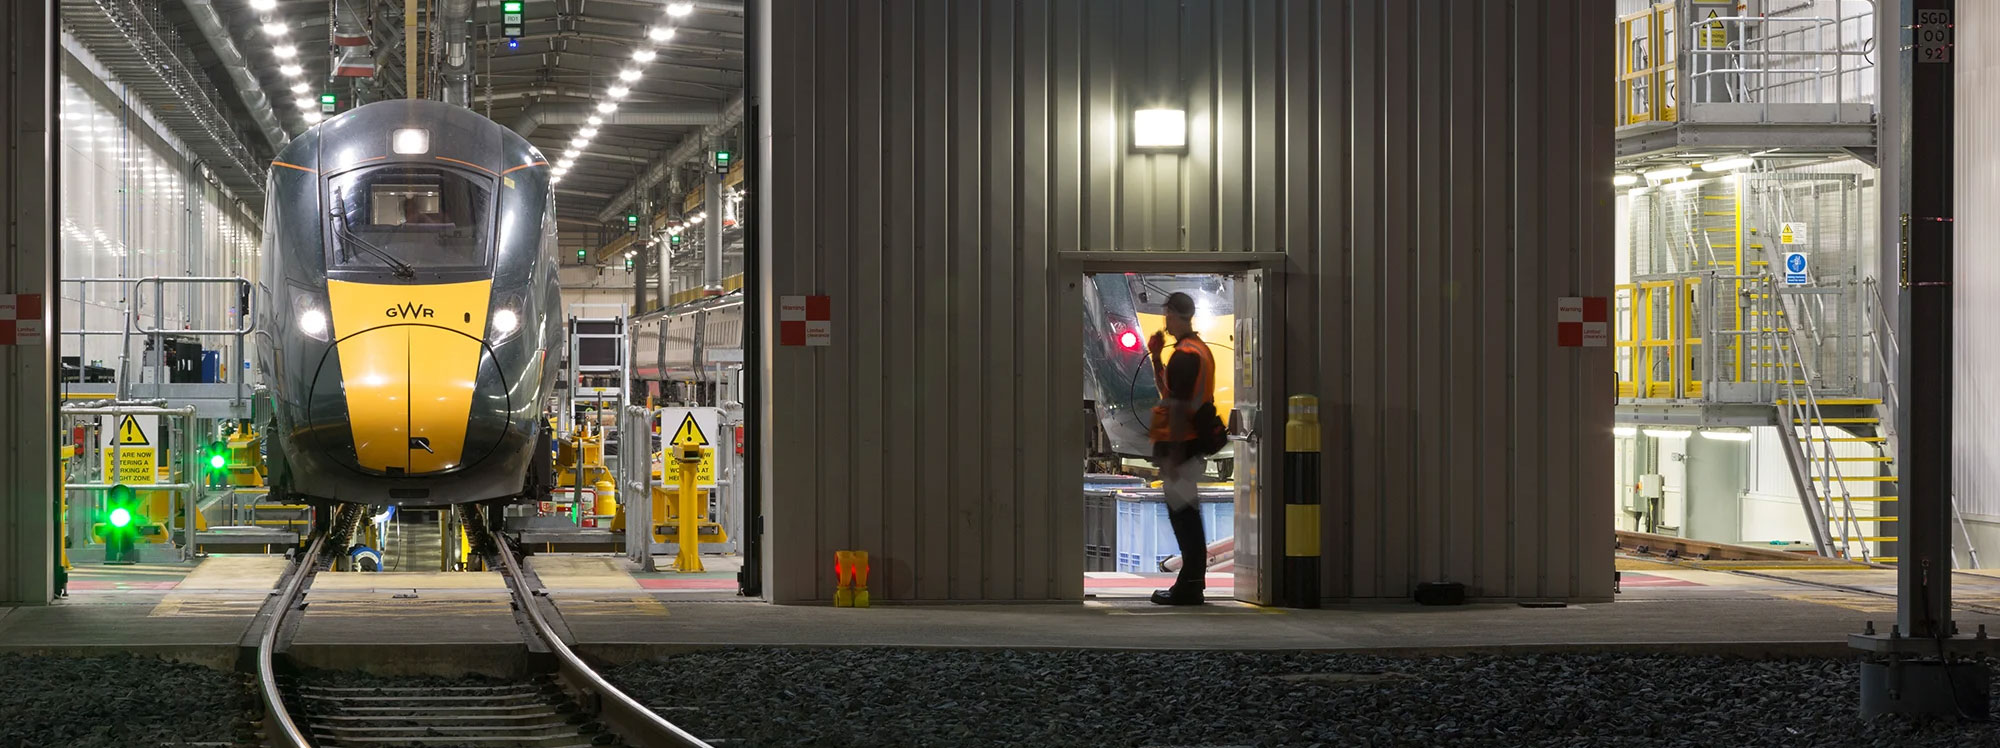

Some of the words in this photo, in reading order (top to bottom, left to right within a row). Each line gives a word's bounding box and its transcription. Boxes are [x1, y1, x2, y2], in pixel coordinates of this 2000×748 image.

[1921, 12, 1948, 24] SGD
[1925, 48, 1943, 60] 92
[386, 300, 434, 319] GWR
